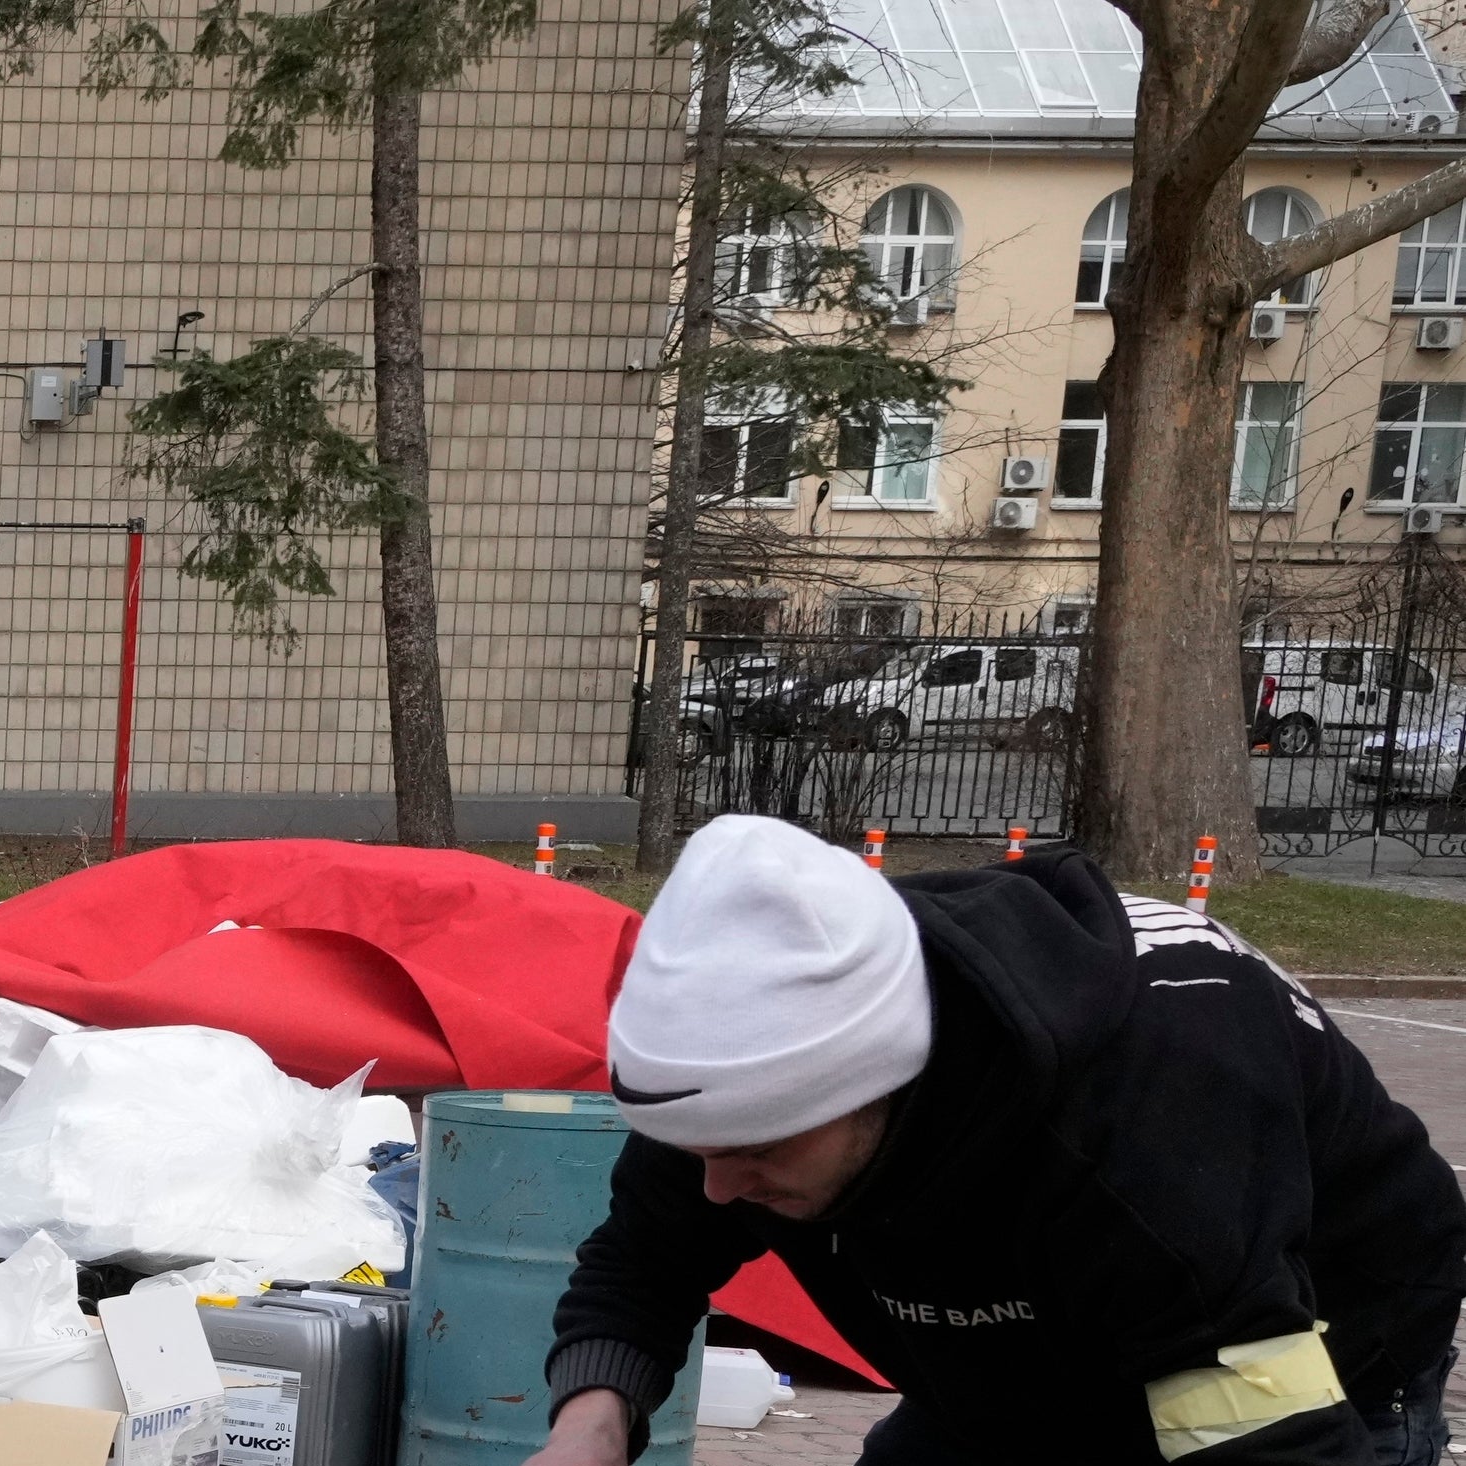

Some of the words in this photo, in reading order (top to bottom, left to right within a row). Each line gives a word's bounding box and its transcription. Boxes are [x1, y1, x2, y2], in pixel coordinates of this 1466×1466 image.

[881, 1295, 939, 1324] THE
[945, 1301, 1035, 1327] BAND
[225, 1433, 286, 1451] YUKO
